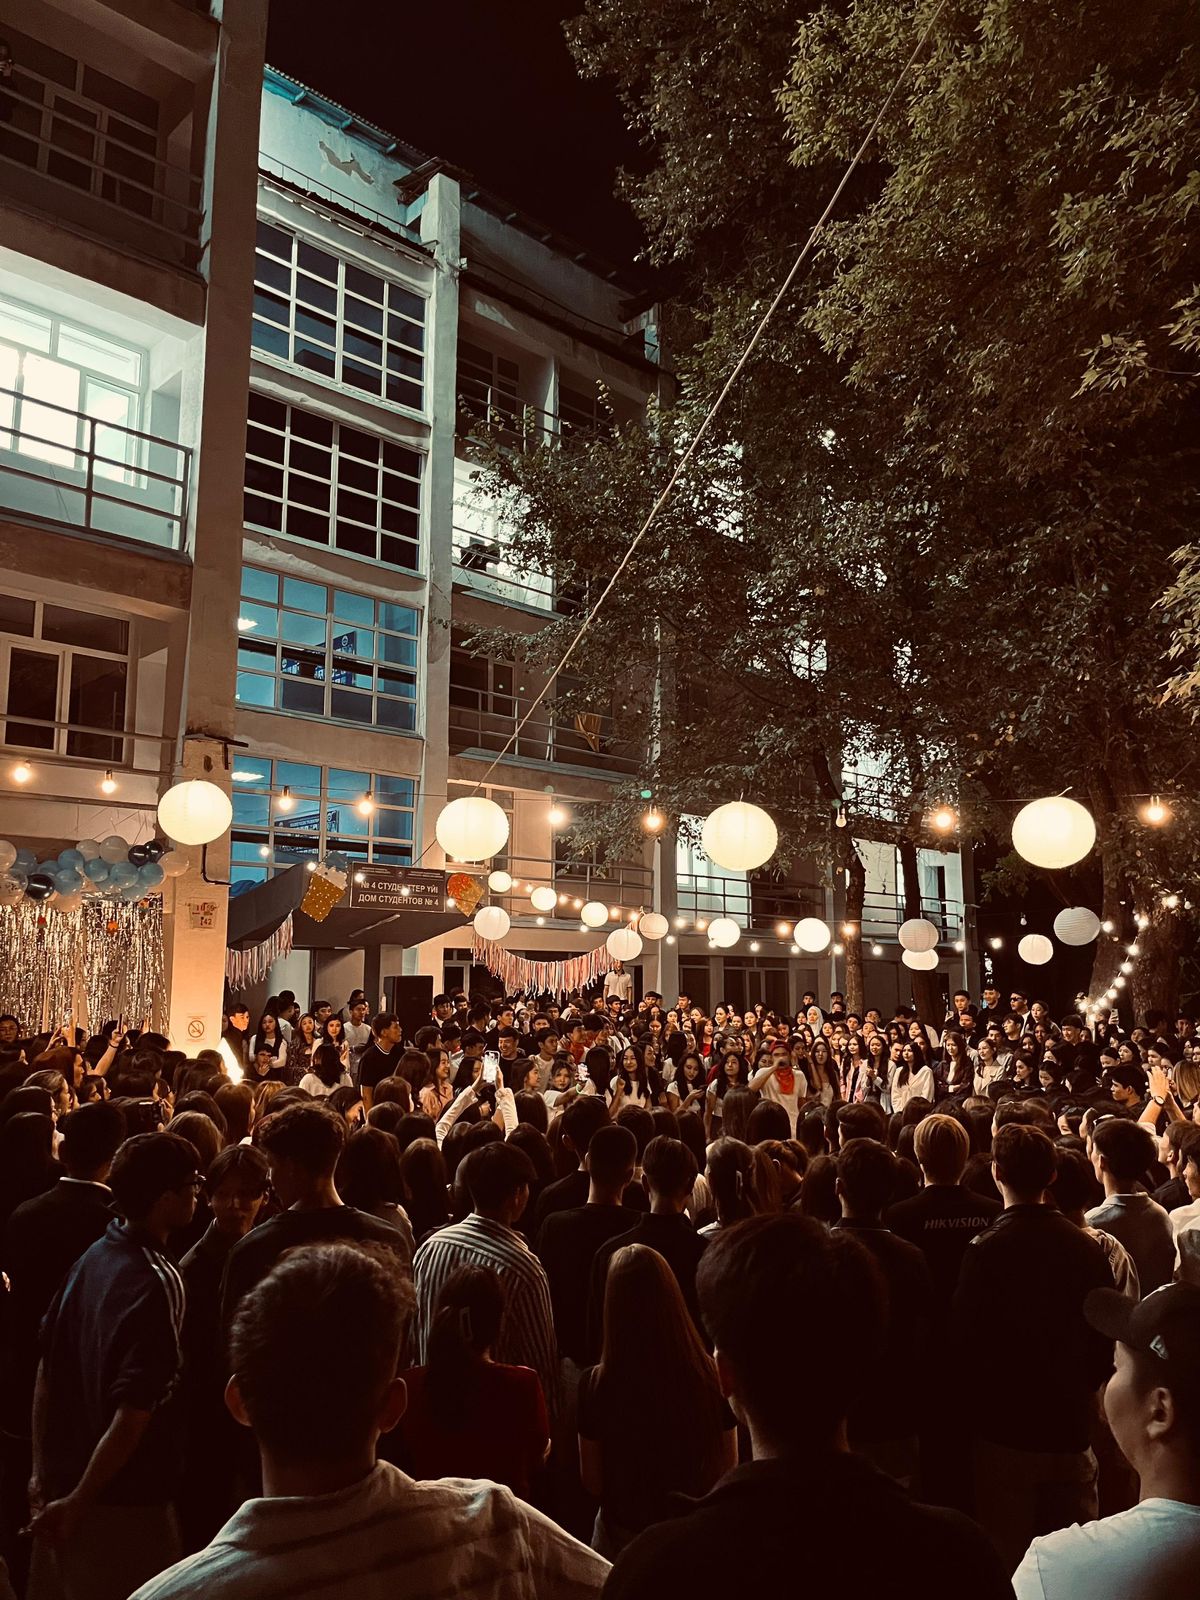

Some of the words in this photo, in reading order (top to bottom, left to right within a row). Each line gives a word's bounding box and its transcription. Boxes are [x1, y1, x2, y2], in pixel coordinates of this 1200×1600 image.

[358, 893, 377, 902] ДОМ
[378, 895, 423, 905] СТУДЕНТОВ
[924, 1217, 989, 1230] HIKVISION
